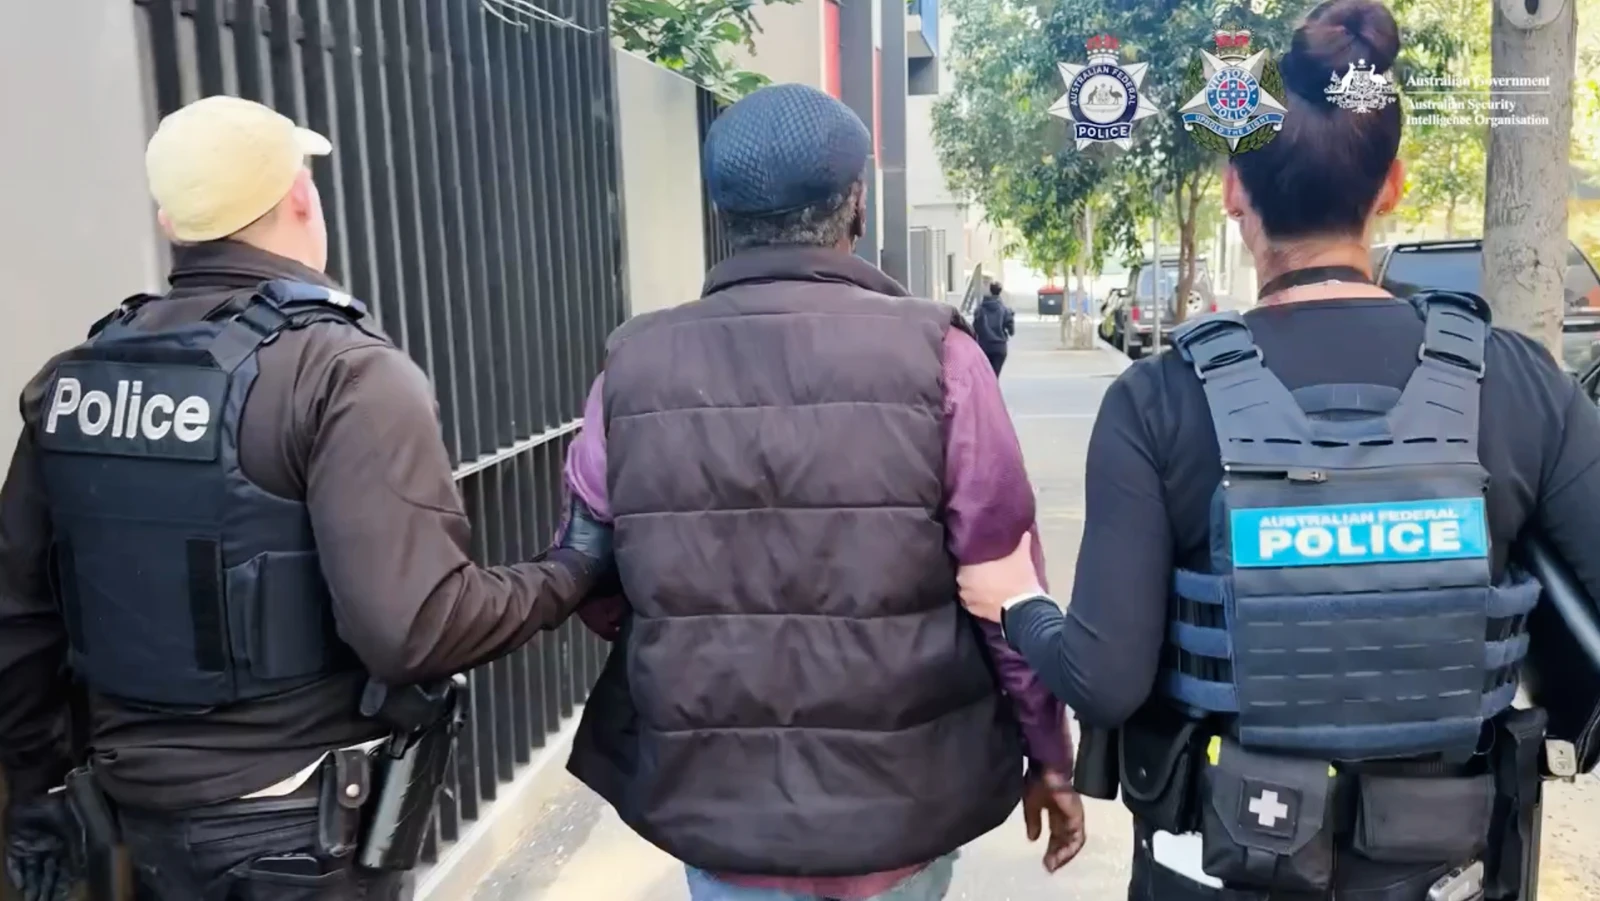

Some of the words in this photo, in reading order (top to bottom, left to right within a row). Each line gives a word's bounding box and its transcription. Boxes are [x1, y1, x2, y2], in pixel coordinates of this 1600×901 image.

[46, 377, 211, 443] Police
[1259, 512, 1374, 528] AUSTRALIAN
[1378, 508, 1459, 522] FEDERAL
[1258, 520, 1462, 560] POLICE
